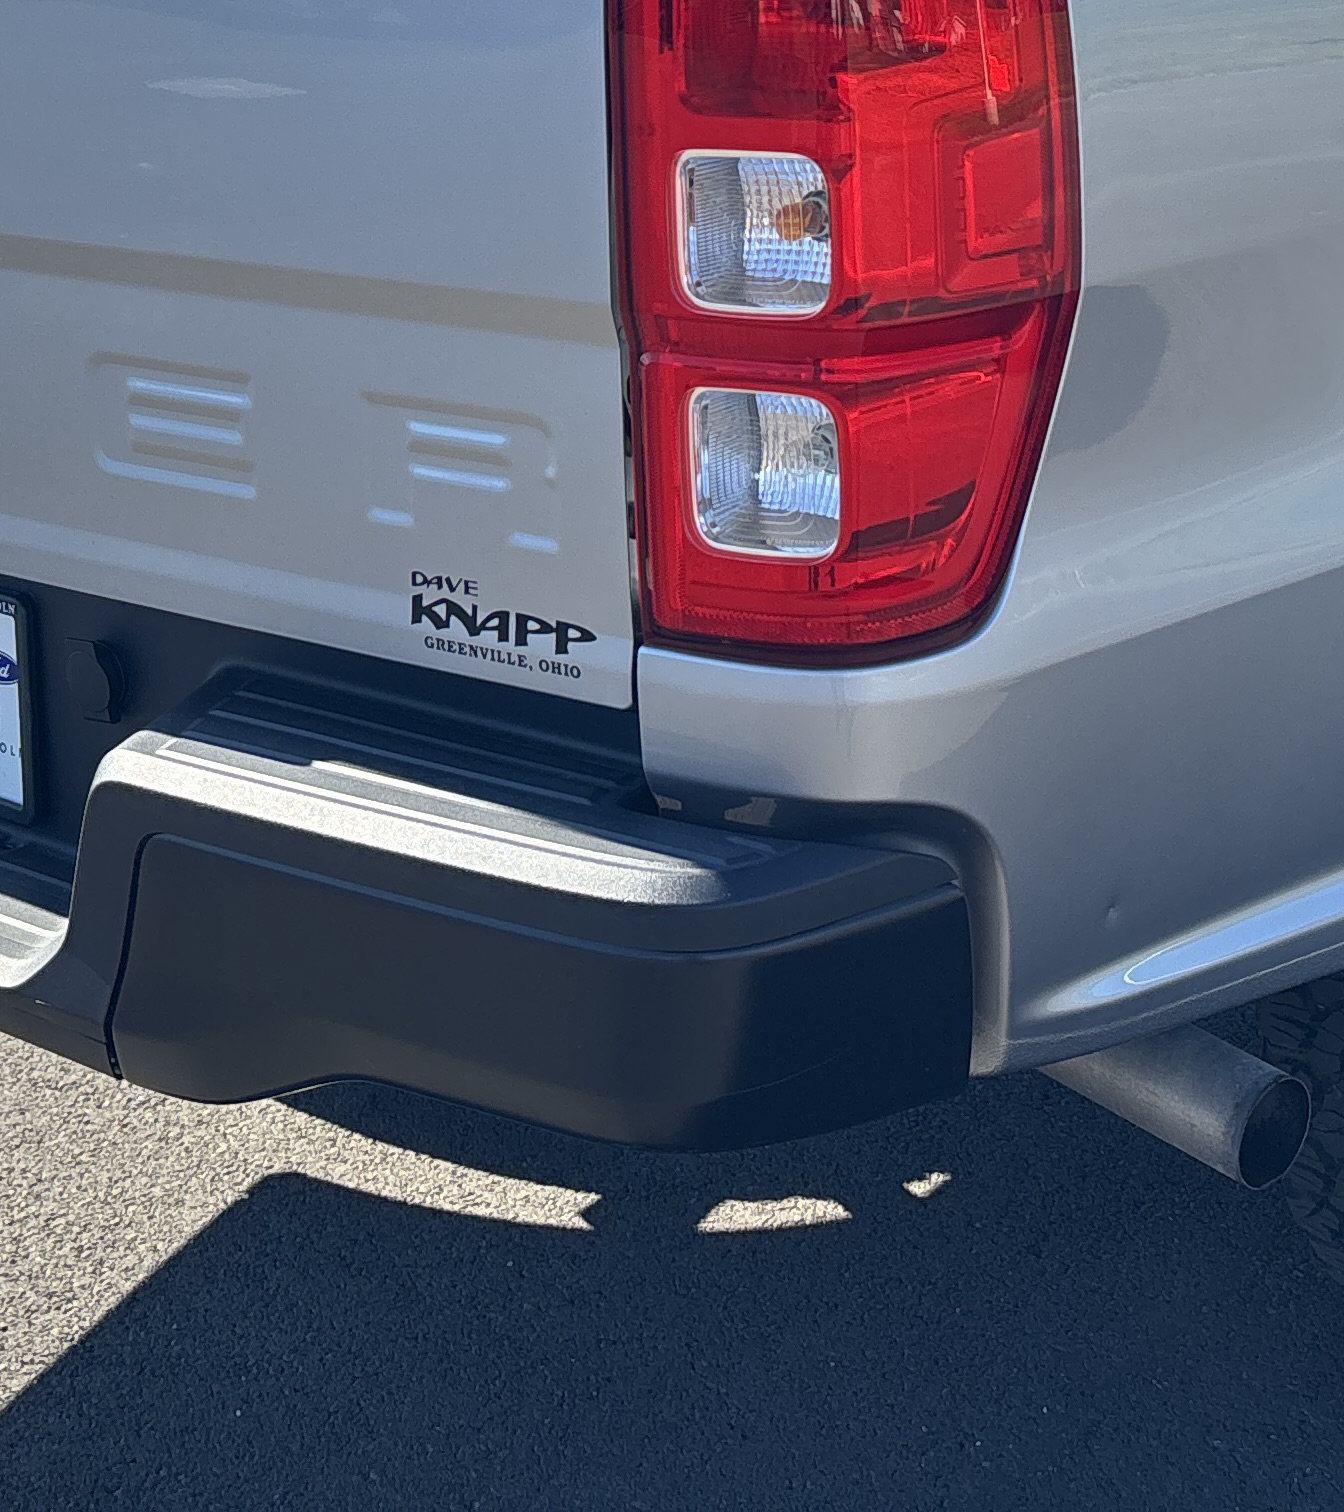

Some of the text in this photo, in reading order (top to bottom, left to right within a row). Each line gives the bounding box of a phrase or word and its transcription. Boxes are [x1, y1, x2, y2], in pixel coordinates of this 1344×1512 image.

[411, 570, 479, 597] DAVE
[411, 593, 598, 655] KNAPP
[424, 635, 582, 679] GREENVILLE, OHIO
